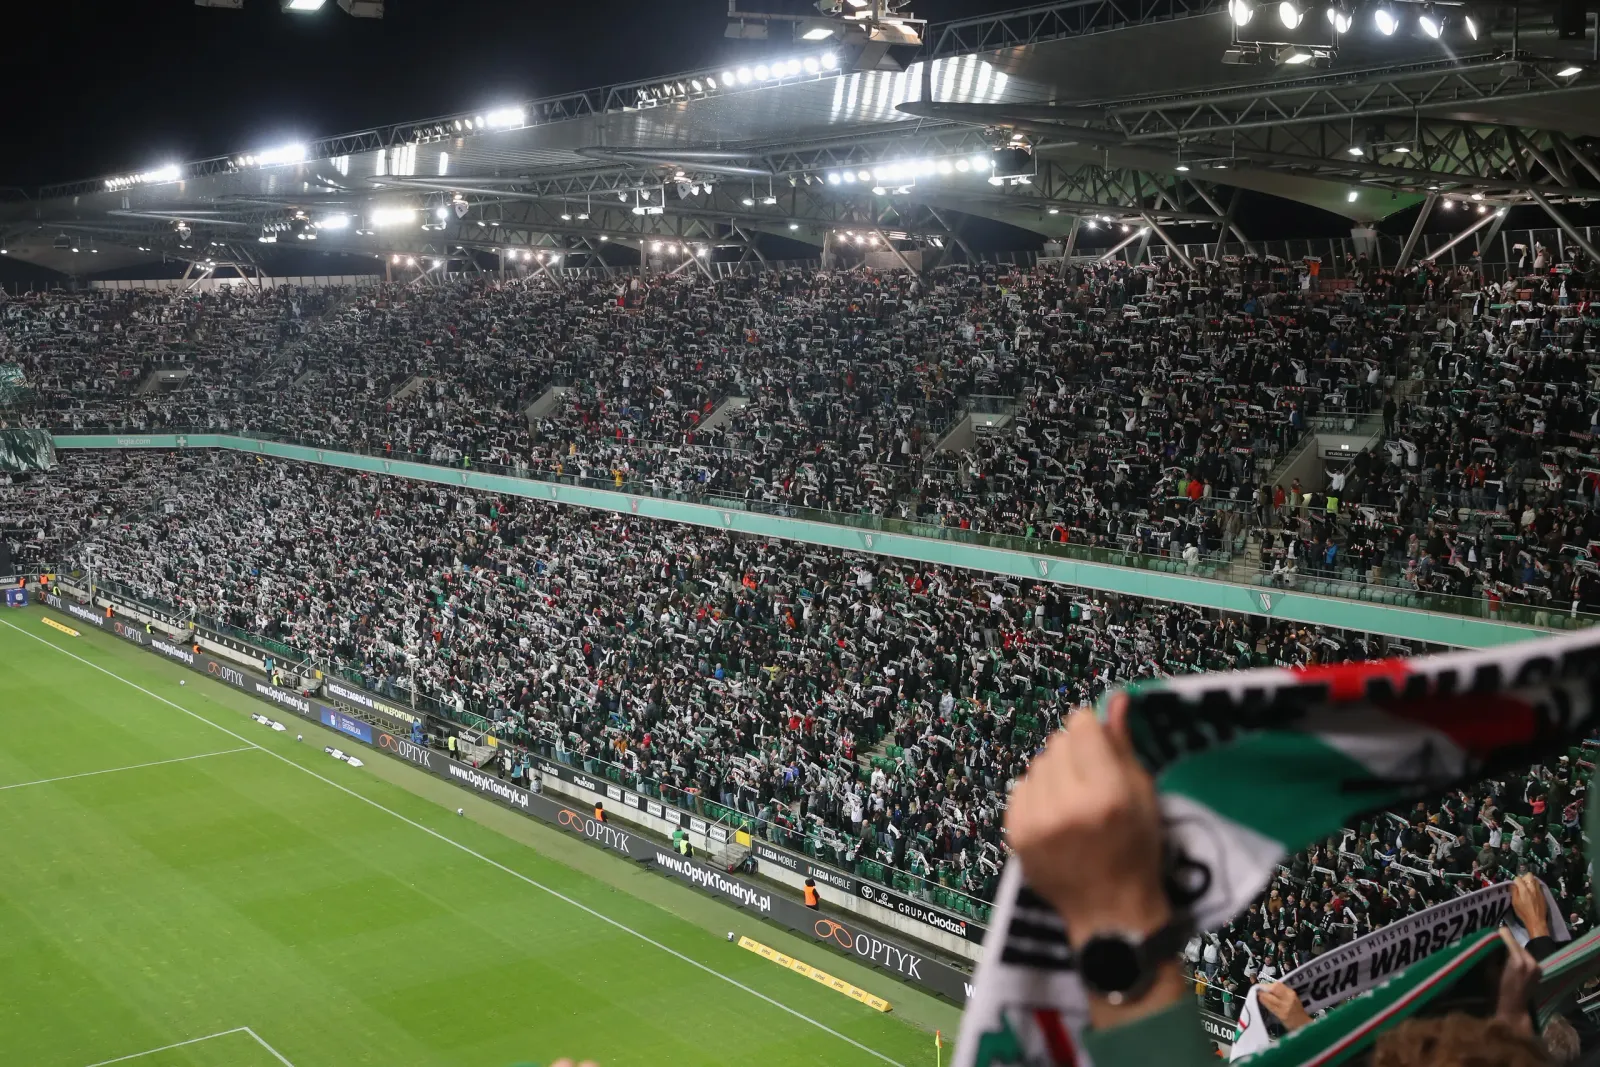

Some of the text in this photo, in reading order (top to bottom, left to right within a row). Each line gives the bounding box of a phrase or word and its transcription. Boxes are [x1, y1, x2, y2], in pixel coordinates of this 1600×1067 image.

[117, 437, 151, 446] legia.com
[124, 625, 143, 643] OPTYK
[221, 666, 244, 687] OPTYK
[256, 683, 310, 714] www.OptykTondryk.pl
[398, 740, 431, 767] OPTYK
[449, 764, 529, 808] www.OptykTondryk.pl
[585, 819, 630, 853] OPTYK
[762, 848, 797, 869] LEGIA MOBILE
[656, 851, 771, 912] www.OptykTondryk.pl
[813, 868, 850, 890] LEGIA MOBILE
[898, 903, 928, 921] GRUPA
[1289, 949, 1363, 986] EPOKONANE
[1367, 925, 1410, 950] MIASTO
[1414, 894, 1491, 929] NIEPOKONANY
[1295, 898, 1509, 1006] EGIA WARSZAW
[855, 934, 922, 980] OPTYK
[1203, 1020, 1235, 1042] GIA.CO
